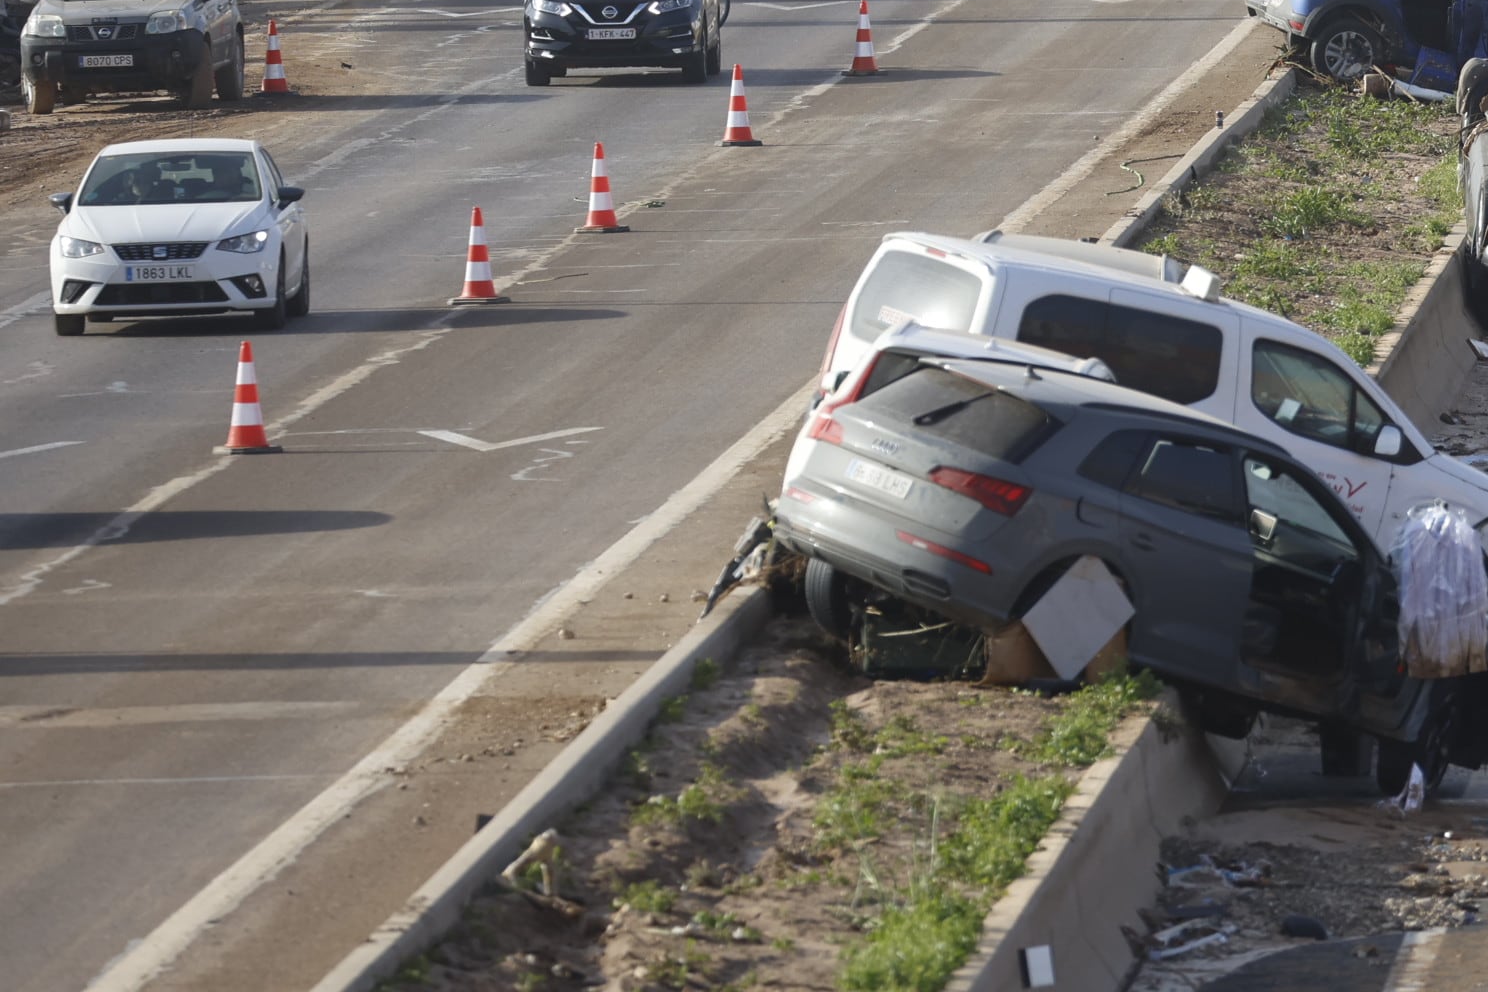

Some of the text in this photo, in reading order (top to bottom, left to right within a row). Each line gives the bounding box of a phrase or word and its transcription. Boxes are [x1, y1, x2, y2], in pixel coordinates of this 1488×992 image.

[86, 56, 132, 66] 8070 CPS
[136, 266, 193, 279] 1863 LKL
